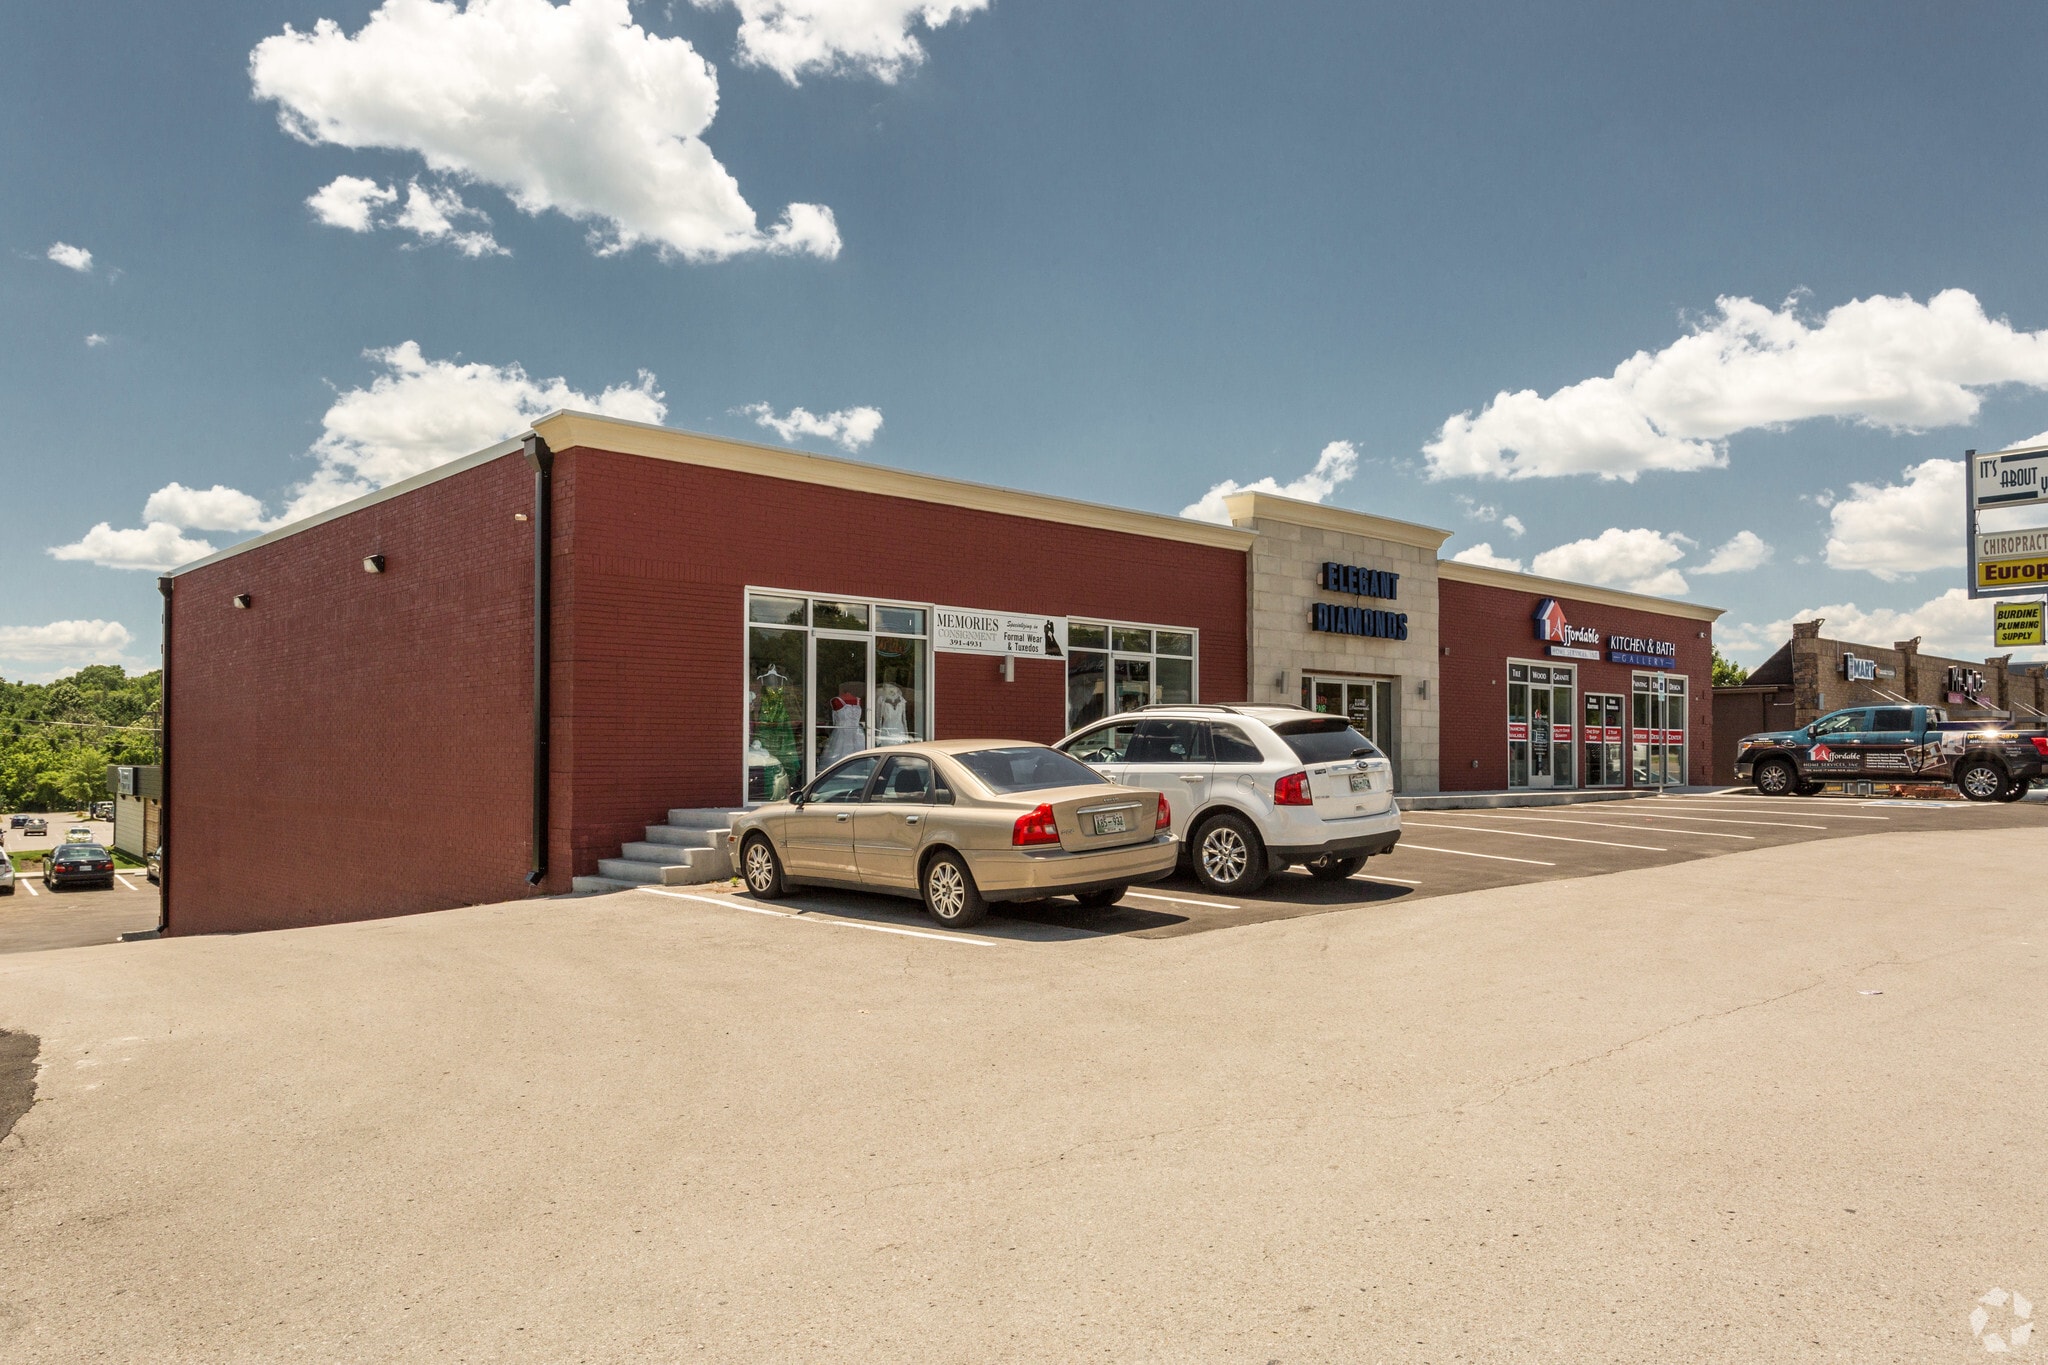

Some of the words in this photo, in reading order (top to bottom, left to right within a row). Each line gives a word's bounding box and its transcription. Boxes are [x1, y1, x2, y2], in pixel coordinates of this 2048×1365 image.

[1980, 459, 1998, 478] IT'S
[2000, 467, 2038, 488] ABOUT
[1322, 562, 1399, 600] ELEGANT
[1997, 608, 2039, 620] BURDINE
[937, 613, 999, 631] MEMORIES
[1312, 603, 1408, 641] DIAMONDS
[1996, 620, 2040, 630] PLUMBING
[938, 628, 998, 642] CONSIGNMENT
[1004, 632, 1024, 642] Formal
[1027, 633, 1042, 643] Wear
[1551, 616, 1600, 646] Affordable
[2002, 632, 2032, 641] SUPPLY
[949, 638, 982, 648] 391-4931
[1008, 642, 1012, 650] &
[1015, 642, 1039, 652] Tuxedos
[1610, 636, 1646, 652] KITCHEN
[1648, 638, 1655, 653] &
[1656, 642, 1675, 656] BATH
[1622, 655, 1665, 666] GALLERY
[1854, 660, 1874, 678] MART
[1816, 750, 1860, 762] Affordable
